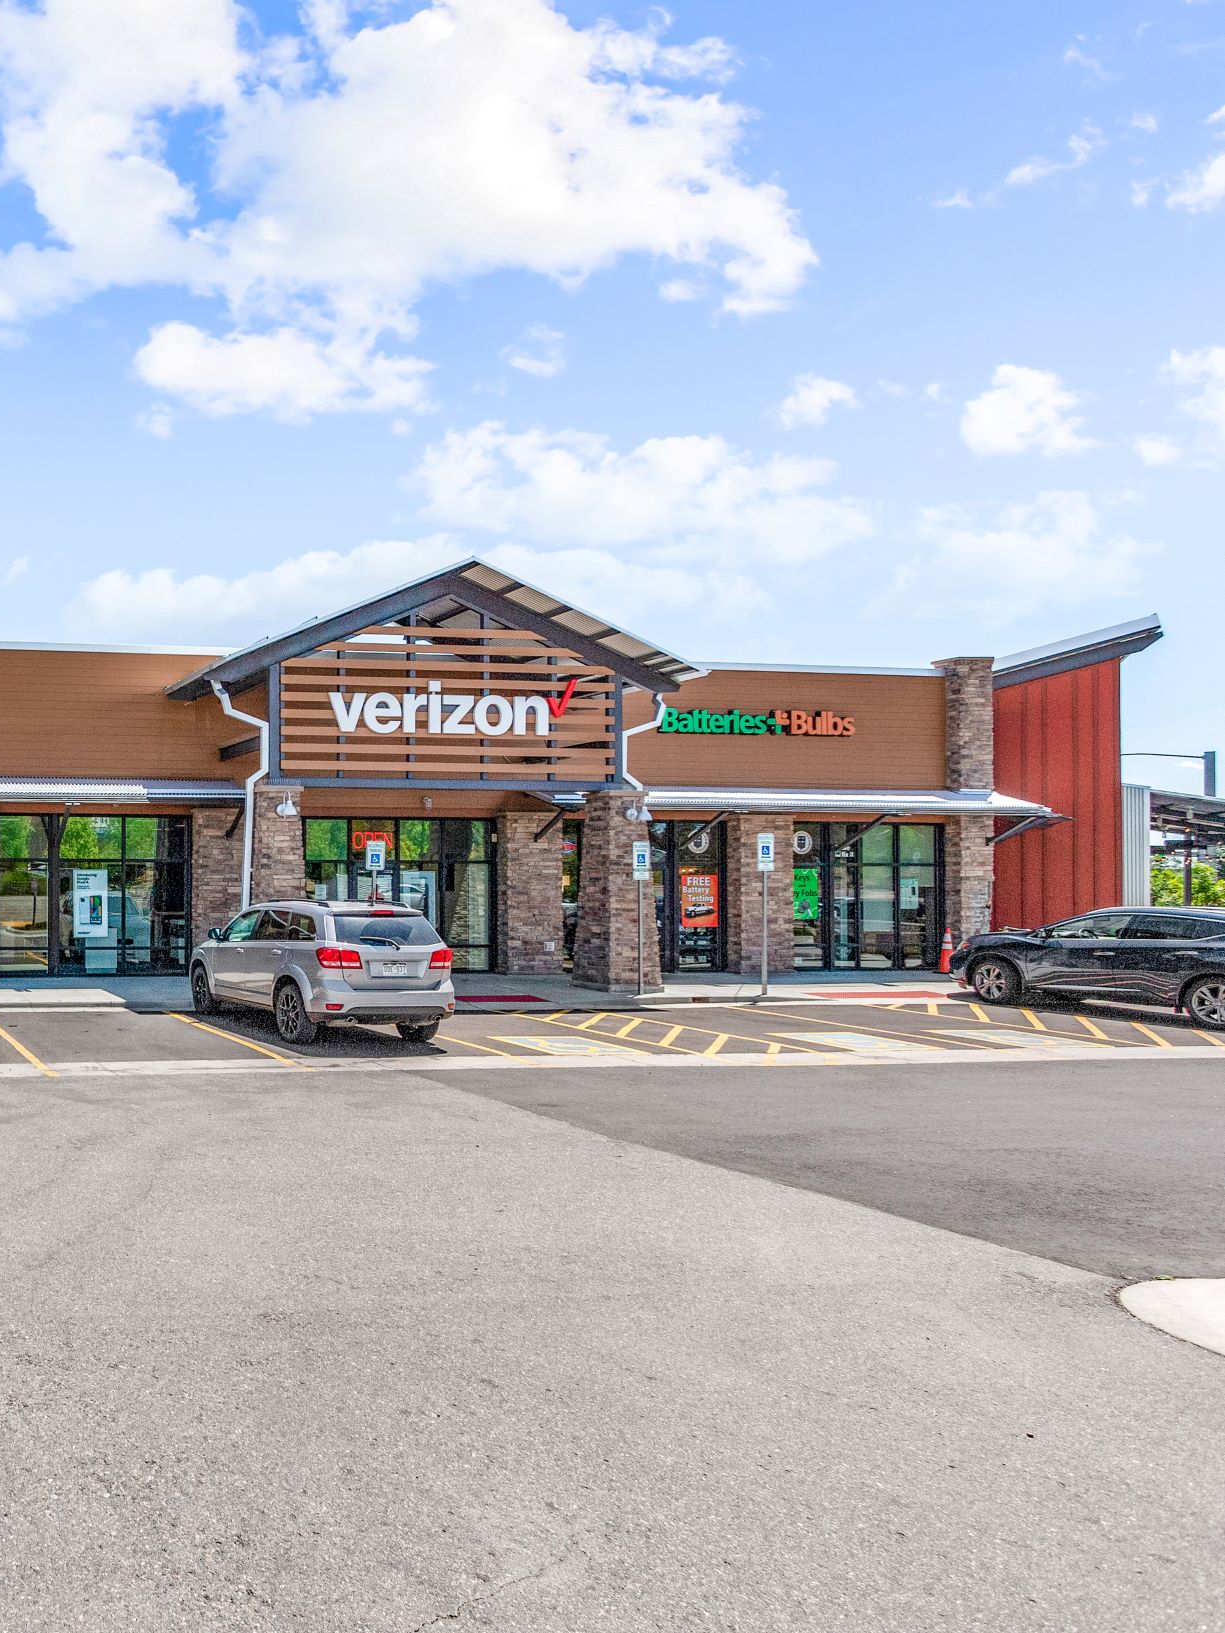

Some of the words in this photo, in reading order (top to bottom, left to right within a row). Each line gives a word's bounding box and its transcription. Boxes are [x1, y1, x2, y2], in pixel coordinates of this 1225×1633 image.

[328, 680, 550, 736] verizon
[790, 709, 856, 736] Bulbs
[687, 876, 711, 886] FREE
[682, 885, 710, 895] Battery
[801, 889, 818, 897] Fobs
[688, 895, 714, 904] Testing
